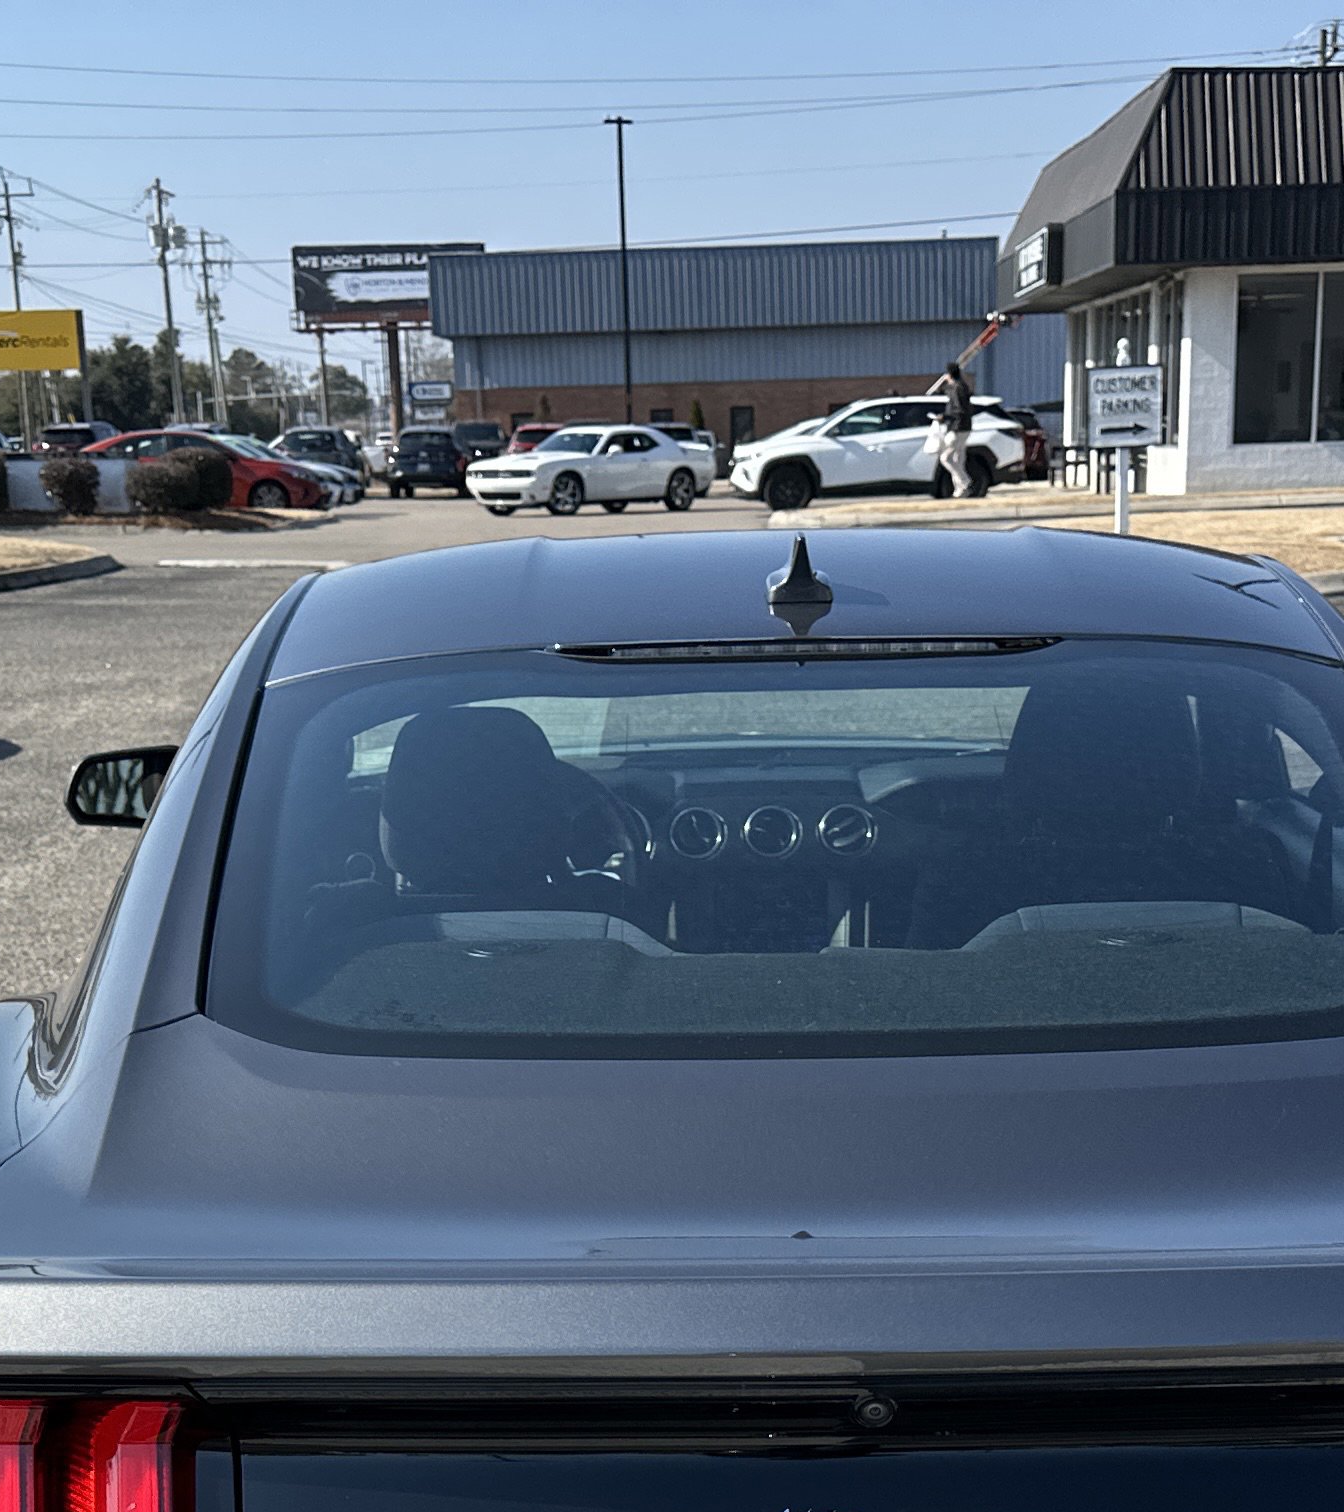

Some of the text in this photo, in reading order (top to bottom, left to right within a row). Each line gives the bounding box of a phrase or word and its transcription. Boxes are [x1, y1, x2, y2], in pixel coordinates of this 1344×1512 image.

[296, 255, 320, 268] WE
[321, 254, 363, 268] KNOW
[366, 253, 403, 266] THEIR
[1093, 375, 1158, 394] CUSTOMER
[1099, 397, 1152, 416] PARKING
